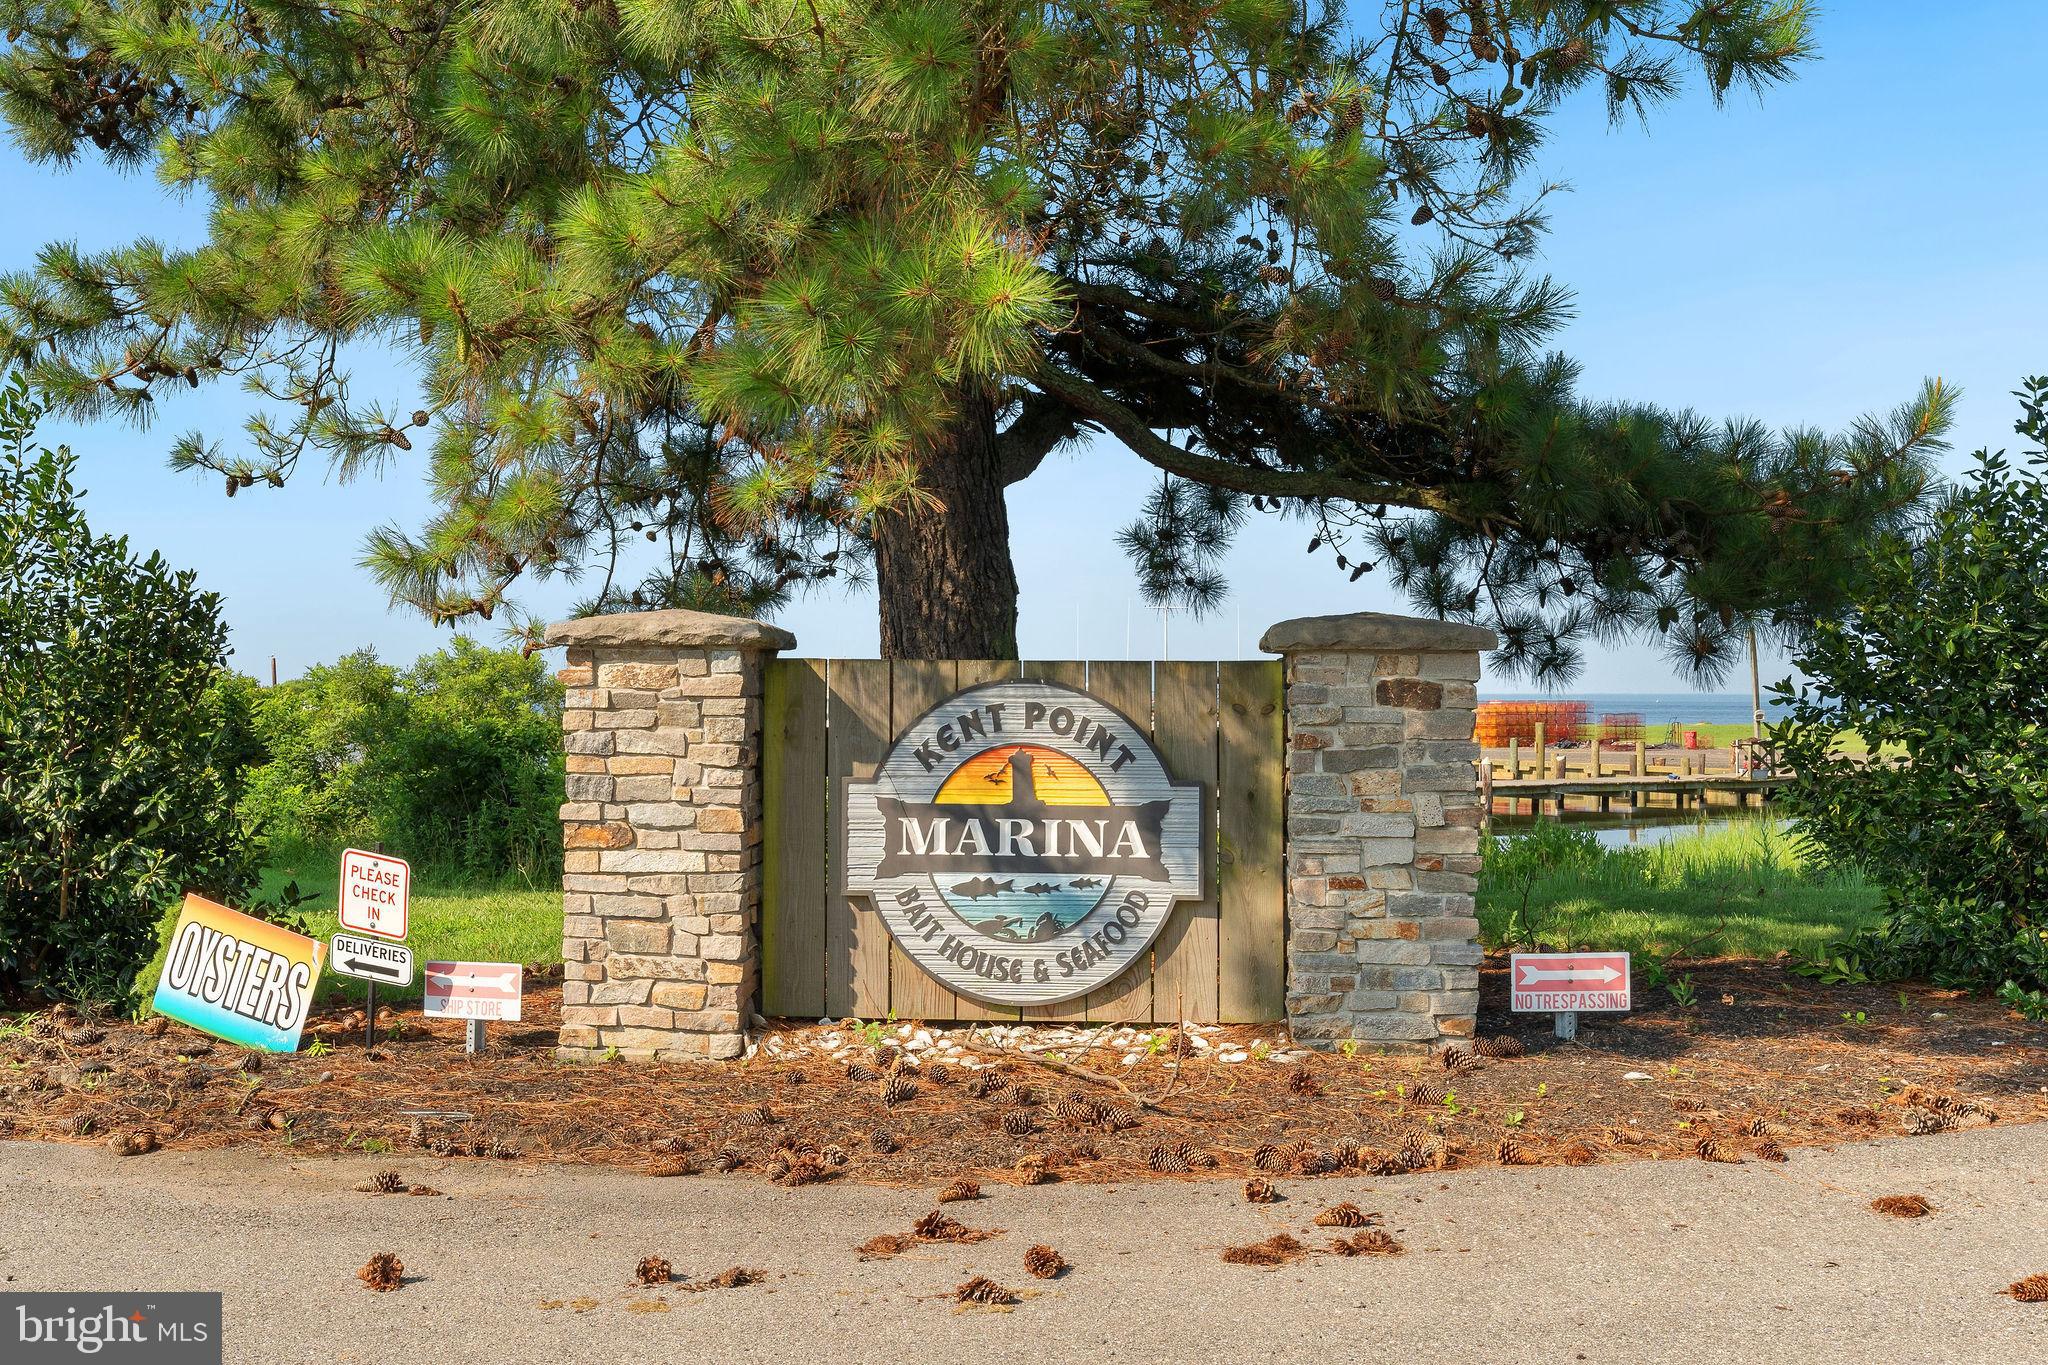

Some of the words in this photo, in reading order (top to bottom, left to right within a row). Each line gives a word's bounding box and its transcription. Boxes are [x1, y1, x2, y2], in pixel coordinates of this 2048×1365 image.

[912, 702, 1007, 774] KENT
[1024, 701, 1137, 774] POINT
[896, 817, 1151, 859] MARINA
[350, 865, 400, 888] PLEASE
[352, 884, 396, 906] CHECK
[367, 906, 381, 922] IN
[894, 885, 945, 943] BAIT
[937, 935, 1023, 984] HOUSE
[1032, 959, 1051, 984] &
[1055, 889, 1150, 979] SEAFOOD
[336, 938, 407, 965] DELIVERIES
[168, 921, 311, 1031] OYSTERS
[439, 997, 464, 1015] SHIP
[466, 999, 503, 1017] STORE
[1515, 993, 1533, 1010] NO
[1535, 992, 1628, 1010] TRESPASSING
